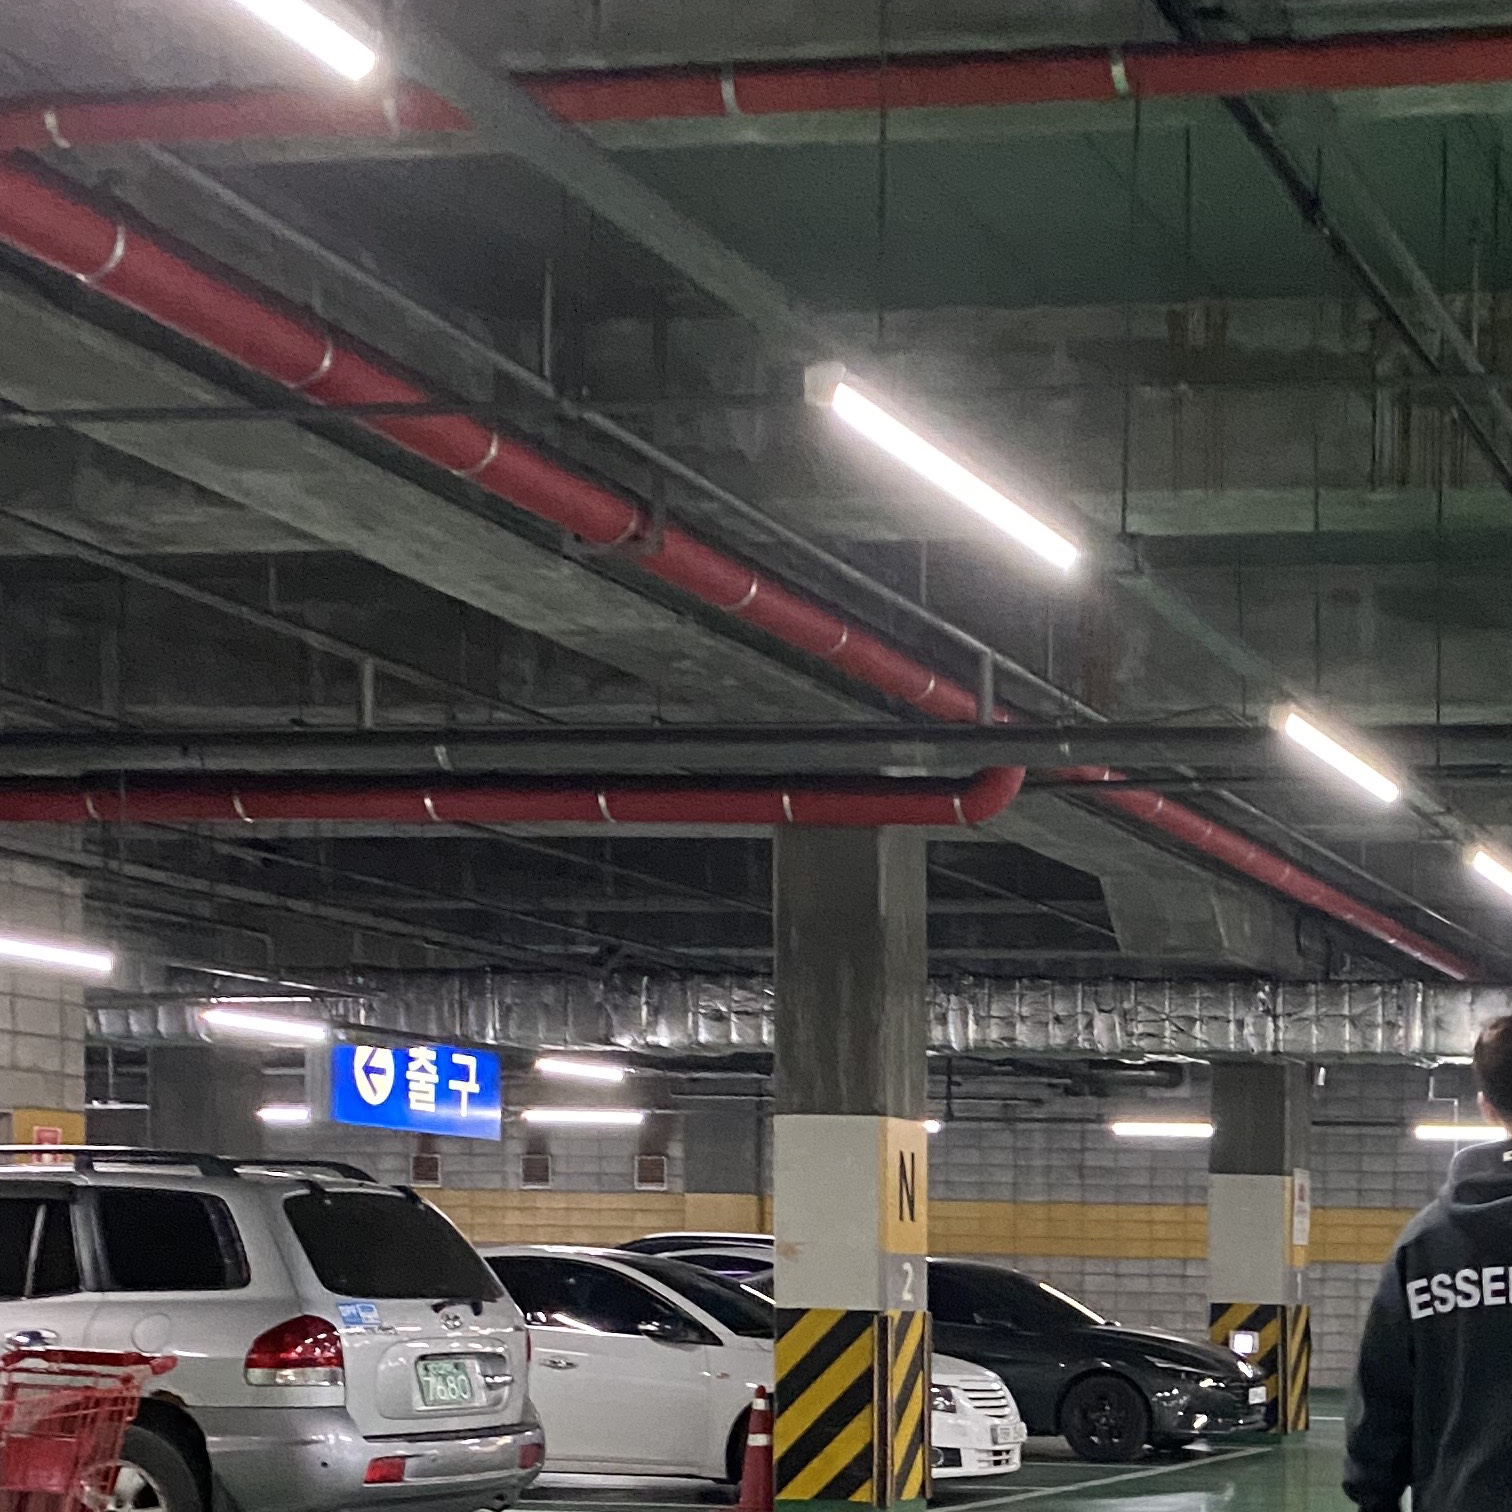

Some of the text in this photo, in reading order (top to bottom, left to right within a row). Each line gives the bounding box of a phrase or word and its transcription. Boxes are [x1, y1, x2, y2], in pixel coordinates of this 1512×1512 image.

[405, 1046, 480, 1118] 출구
[898, 1150, 916, 1222] N
[902, 1262, 914, 1301] 2
